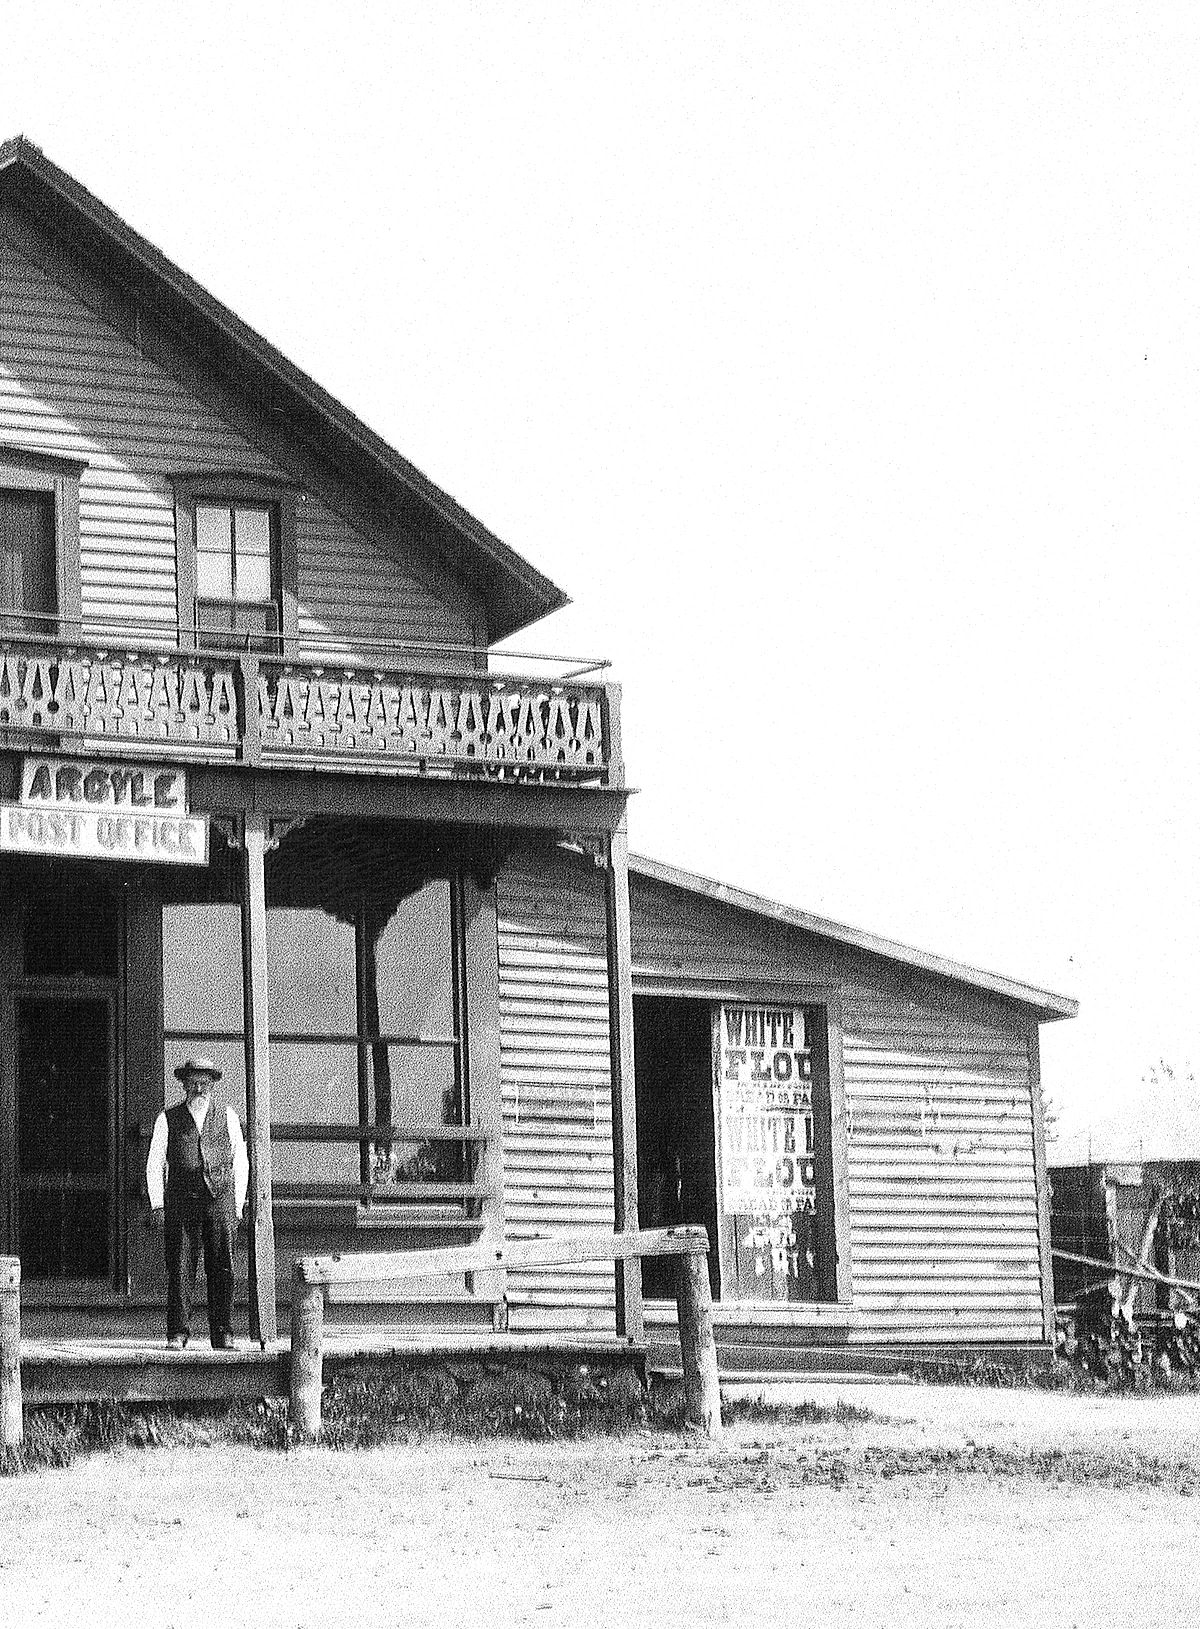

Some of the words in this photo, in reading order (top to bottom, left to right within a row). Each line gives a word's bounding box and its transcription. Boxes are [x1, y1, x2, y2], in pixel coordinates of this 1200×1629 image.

[28, 763, 179, 809] ARGYLE
[8, 810, 87, 848] POST
[96, 816, 198, 857] OFFICE
[724, 1010, 794, 1048] WHITE
